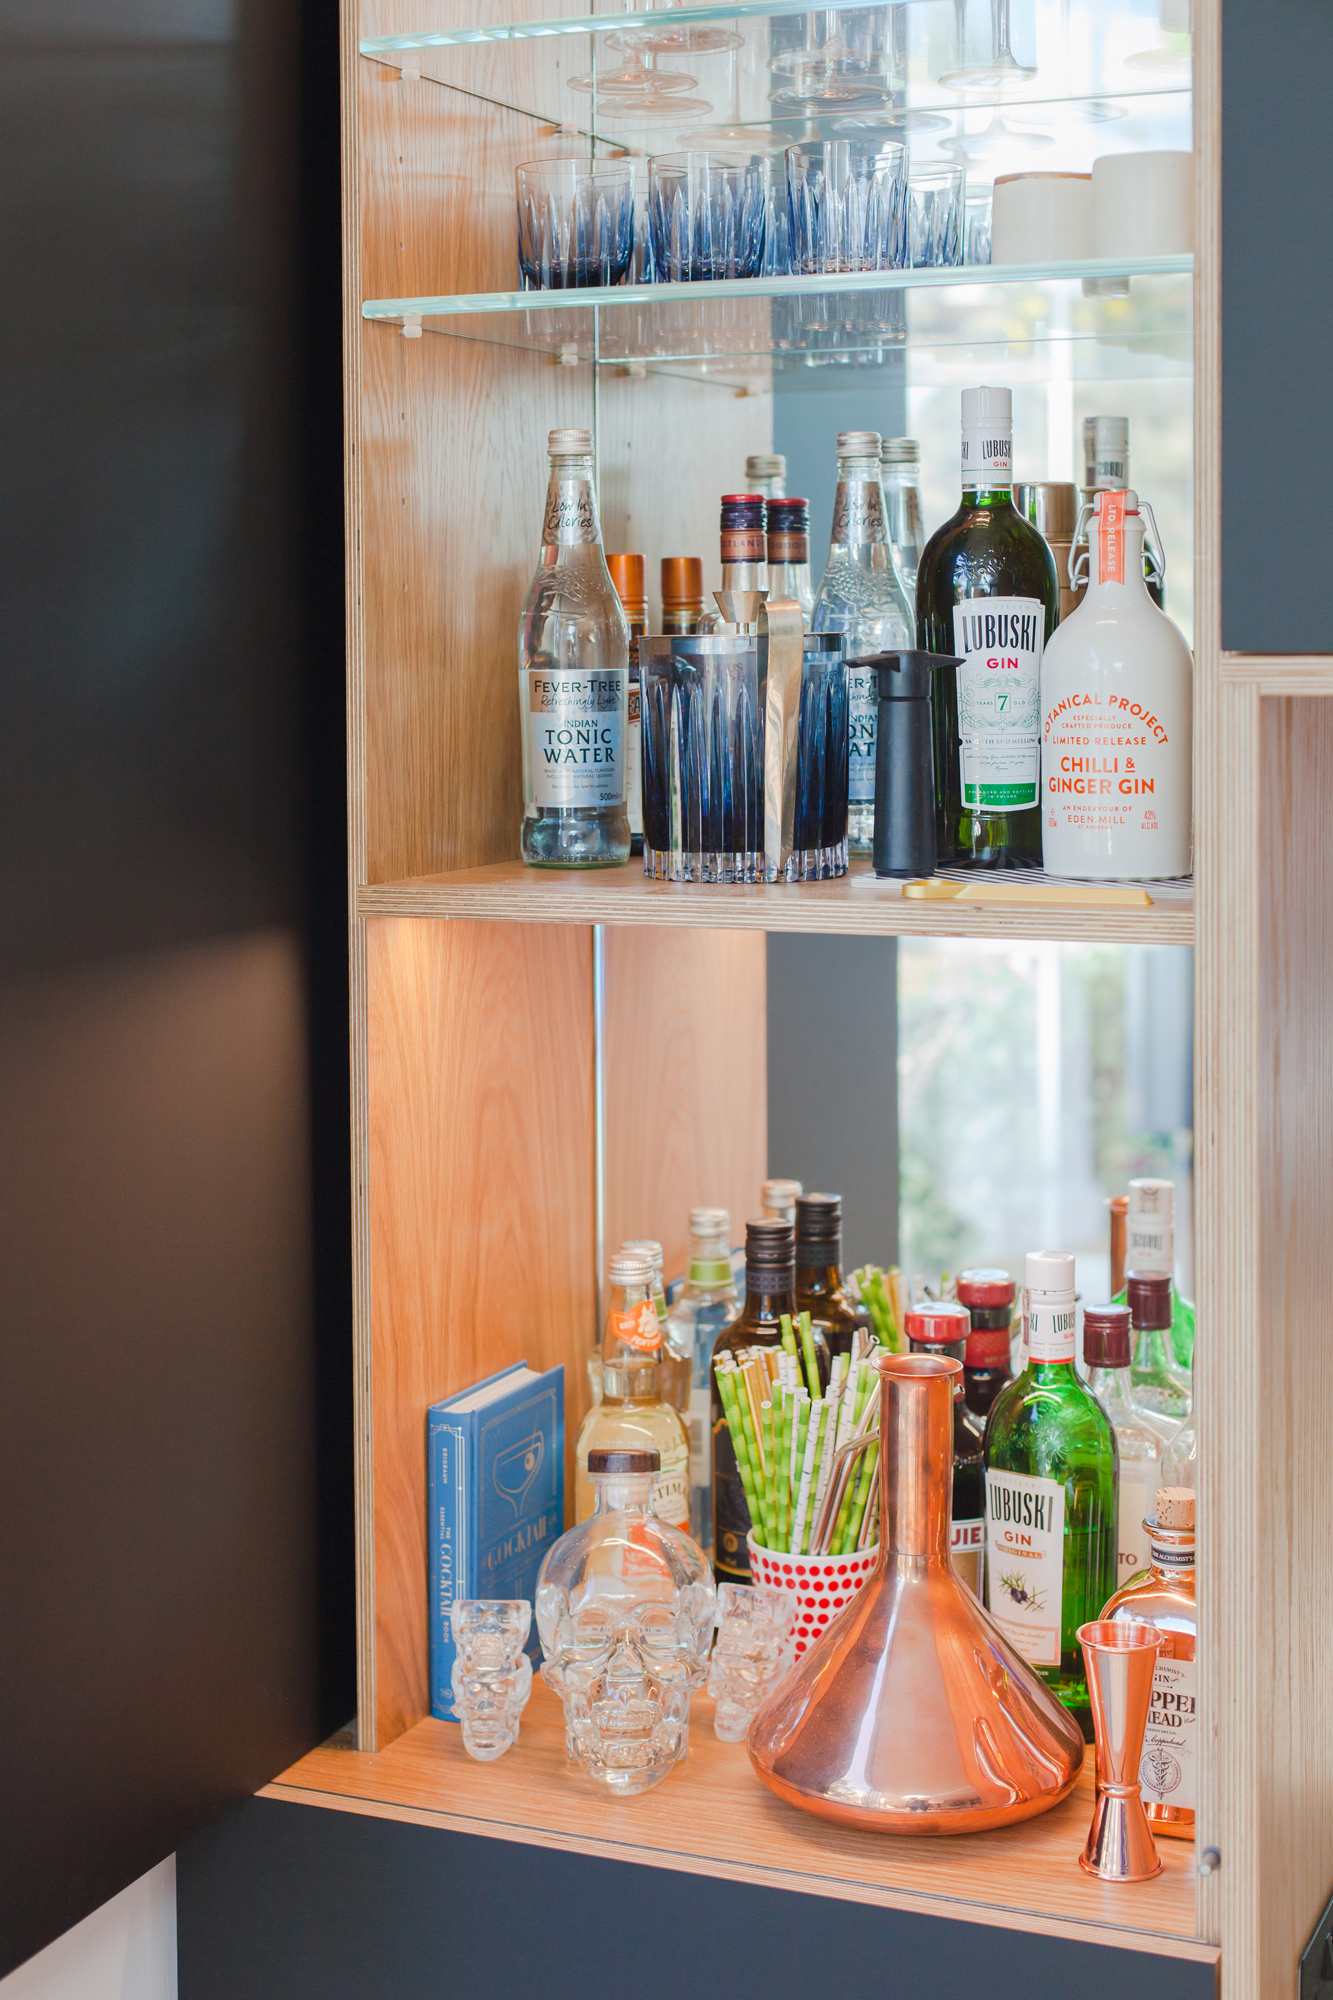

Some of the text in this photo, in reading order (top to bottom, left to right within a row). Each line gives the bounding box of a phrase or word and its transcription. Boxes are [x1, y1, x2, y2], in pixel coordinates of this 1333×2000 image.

[552, 497, 589, 513] Low In
[843, 498, 879, 511] Low In
[547, 512, 592, 530] Calories
[837, 513, 882, 528] Calories
[1107, 504, 1117, 572] LTD. RELEASE
[962, 614, 1037, 654] LUBUSKI
[986, 657, 1019, 669] GIN
[534, 680, 621, 693] FEVER-TREE
[541, 694, 618, 709] Refreshingly Light
[997, 695, 1008, 711] 7
[563, 720, 598, 728] INDIAN
[1108, 694, 1168, 745] PROJECT
[544, 728, 612, 745] TONIC
[1052, 736, 1147, 745] LIMITED RELEASE
[543, 747, 615, 764] WATER
[1060, 756, 1136, 773] CHILLI &
[1048, 776, 1155, 795] GINGER GIN
[1143, 810, 1156, 821] 43%
[1063, 1332, 1075, 1340] GIN
[989, 1483, 1054, 1533] LUBUSKI
[1004, 1530, 1032, 1546] GIN
[998, 1544, 1042, 1559] ORIGINAL
[1159, 1554, 1193, 1562] ALCHEMIST'S
[440, 1543, 453, 1619] COCKTAIL
